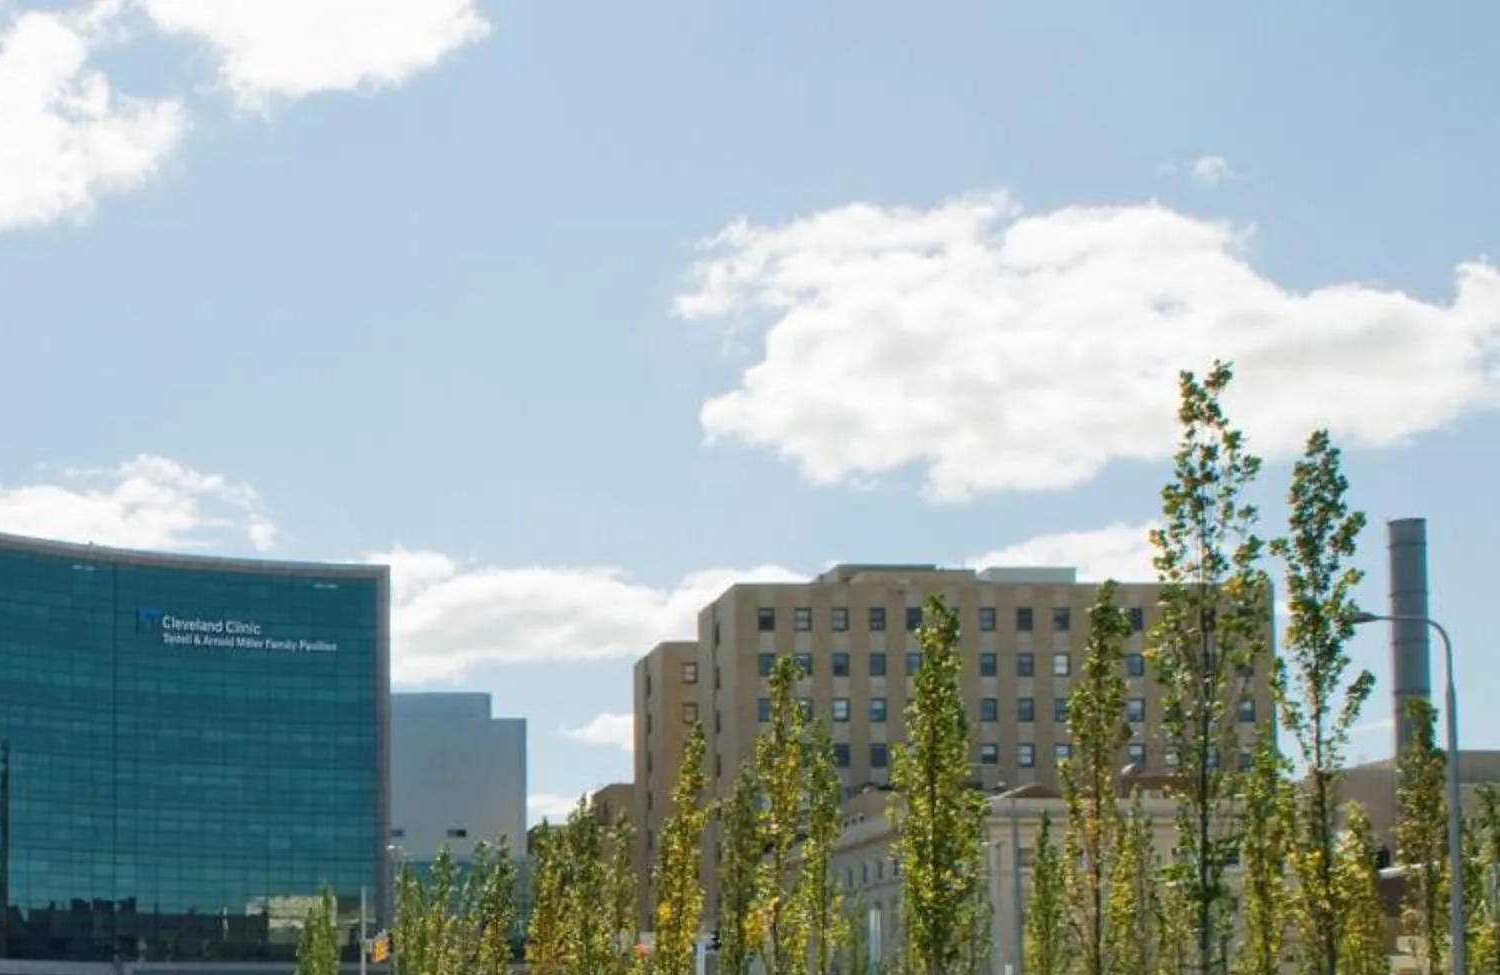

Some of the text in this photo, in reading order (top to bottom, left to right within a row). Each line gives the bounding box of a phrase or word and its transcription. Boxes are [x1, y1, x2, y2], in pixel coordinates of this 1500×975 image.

[163, 616, 261, 635] Cleveland Clinic
[265, 639, 297, 653] Family
